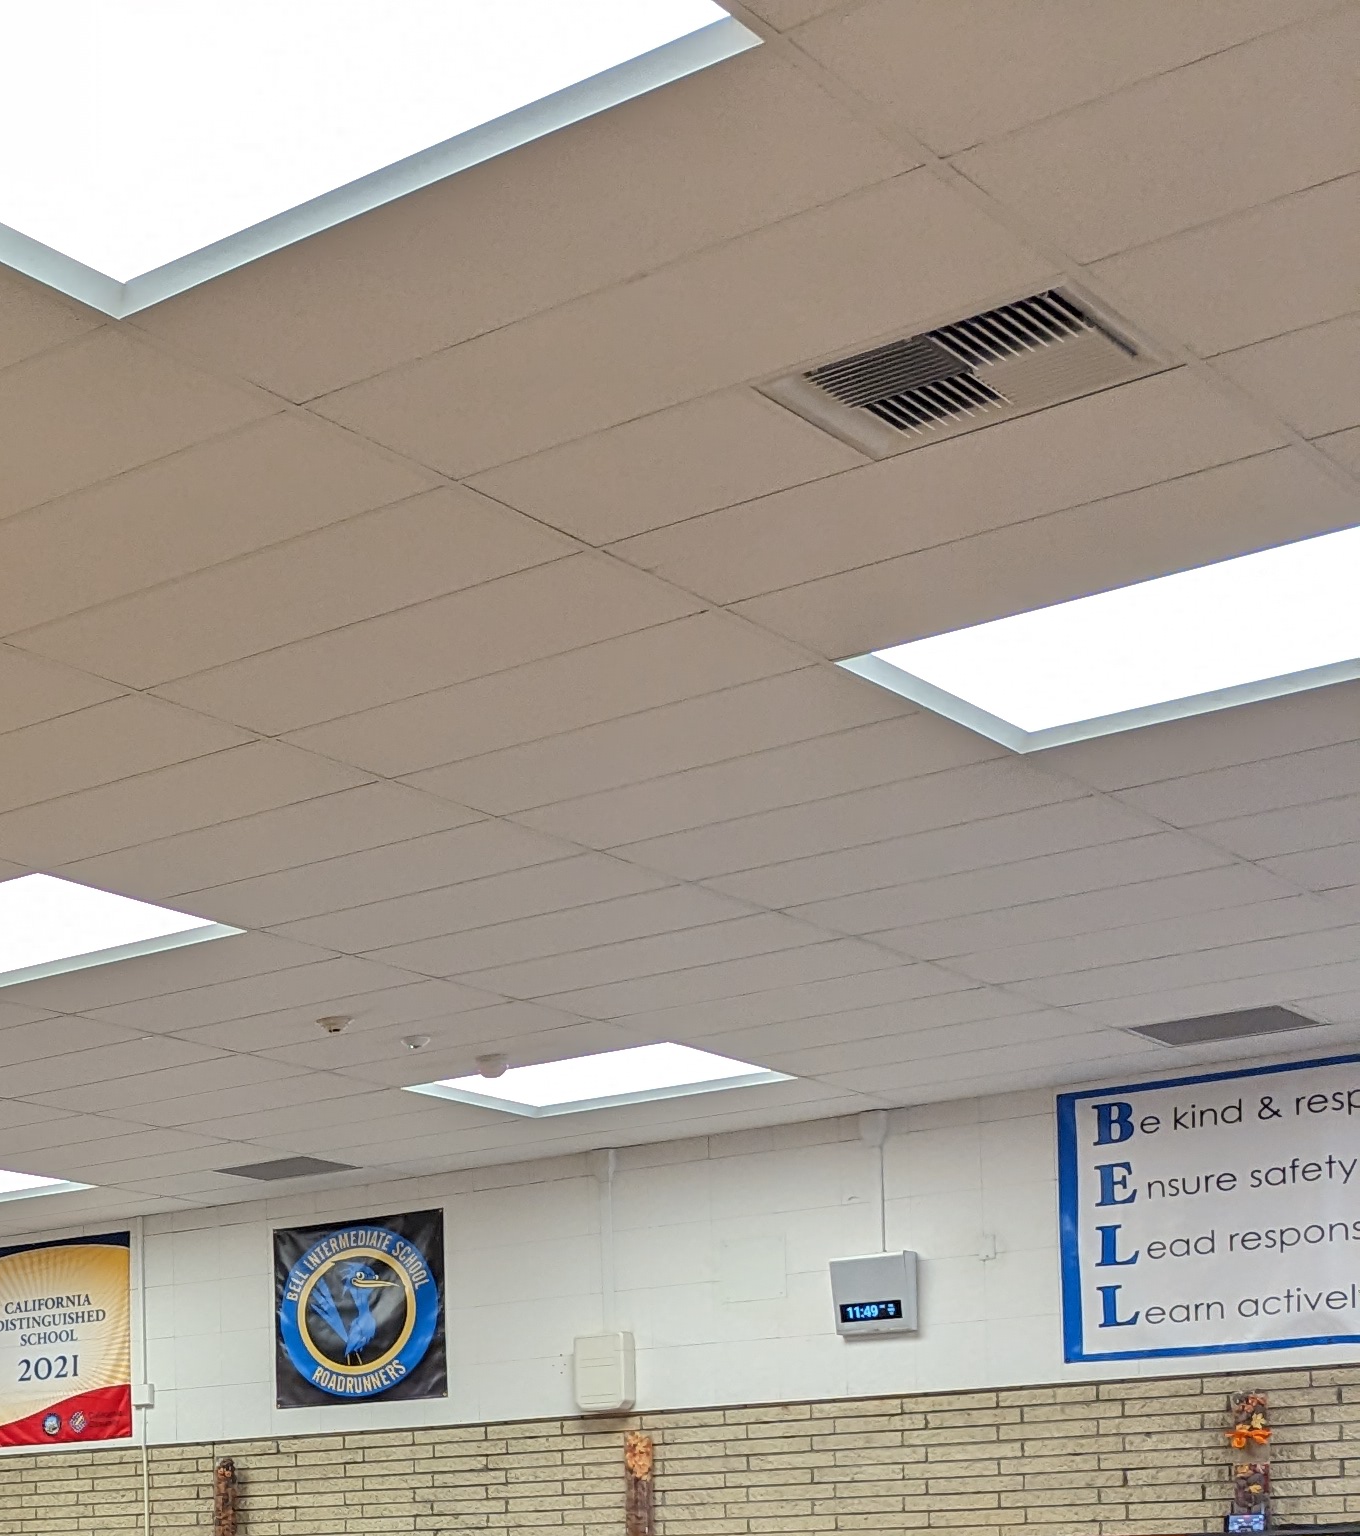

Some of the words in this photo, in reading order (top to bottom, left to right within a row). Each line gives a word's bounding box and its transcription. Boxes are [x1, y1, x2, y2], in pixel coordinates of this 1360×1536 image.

[1092, 1102, 1161, 1146] Be
[1173, 1099, 1243, 1130] kind
[1257, 1096, 1283, 1120] &
[1094, 1161, 1237, 1207] Ensure
[1250, 1154, 1358, 1190] safety
[1095, 1224, 1216, 1267] Lead
[286, 1270, 310, 1302] BELL
[303, 1230, 394, 1270] INTERMEDIATE
[391, 1240, 431, 1290] SCHOOL
[4, 1293, 92, 1315] CALIFORNIA
[846, 1304, 879, 1319] 11:49
[1096, 1284, 1225, 1328] Learn
[1237, 1283, 1360, 1318] activel
[19, 1329, 79, 1347] SCHOOL
[17, 1354, 79, 1383] 2021
[312, 1359, 407, 1394] ROADRUNNERS
